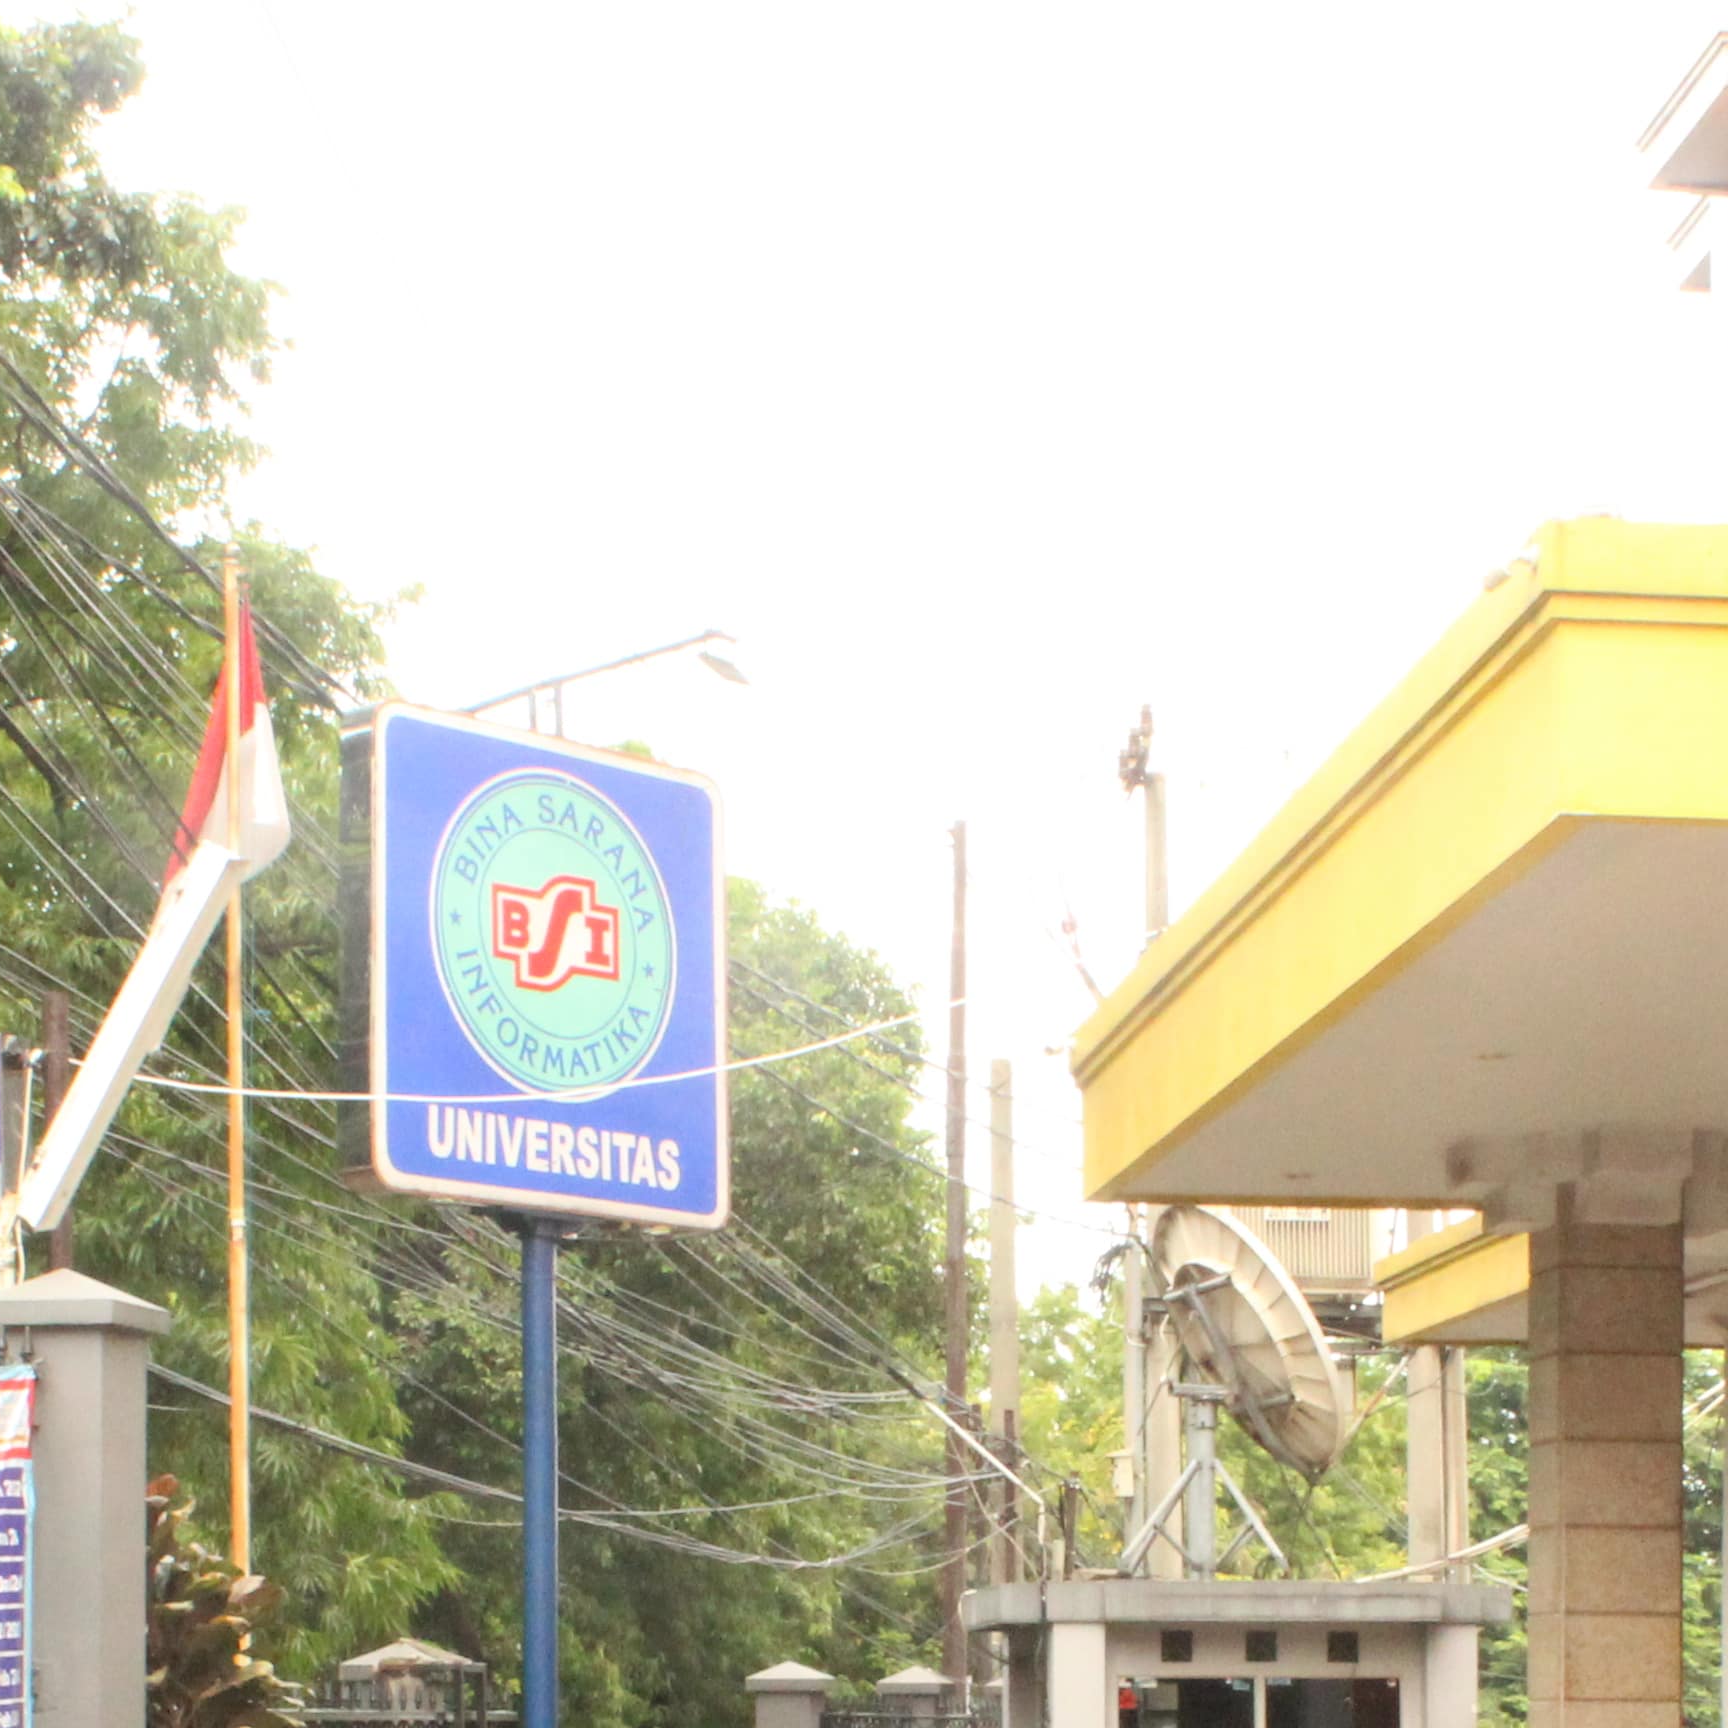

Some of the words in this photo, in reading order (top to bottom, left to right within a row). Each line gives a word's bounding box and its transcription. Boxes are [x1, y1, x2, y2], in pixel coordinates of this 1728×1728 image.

[454, 800, 524, 886] BINA
[537, 794, 656, 934] SARANA
[501, 889, 613, 979] BSI
[456, 948, 652, 1080] INFORMATIKA
[428, 1103, 682, 1192] UNIVERSITAS
